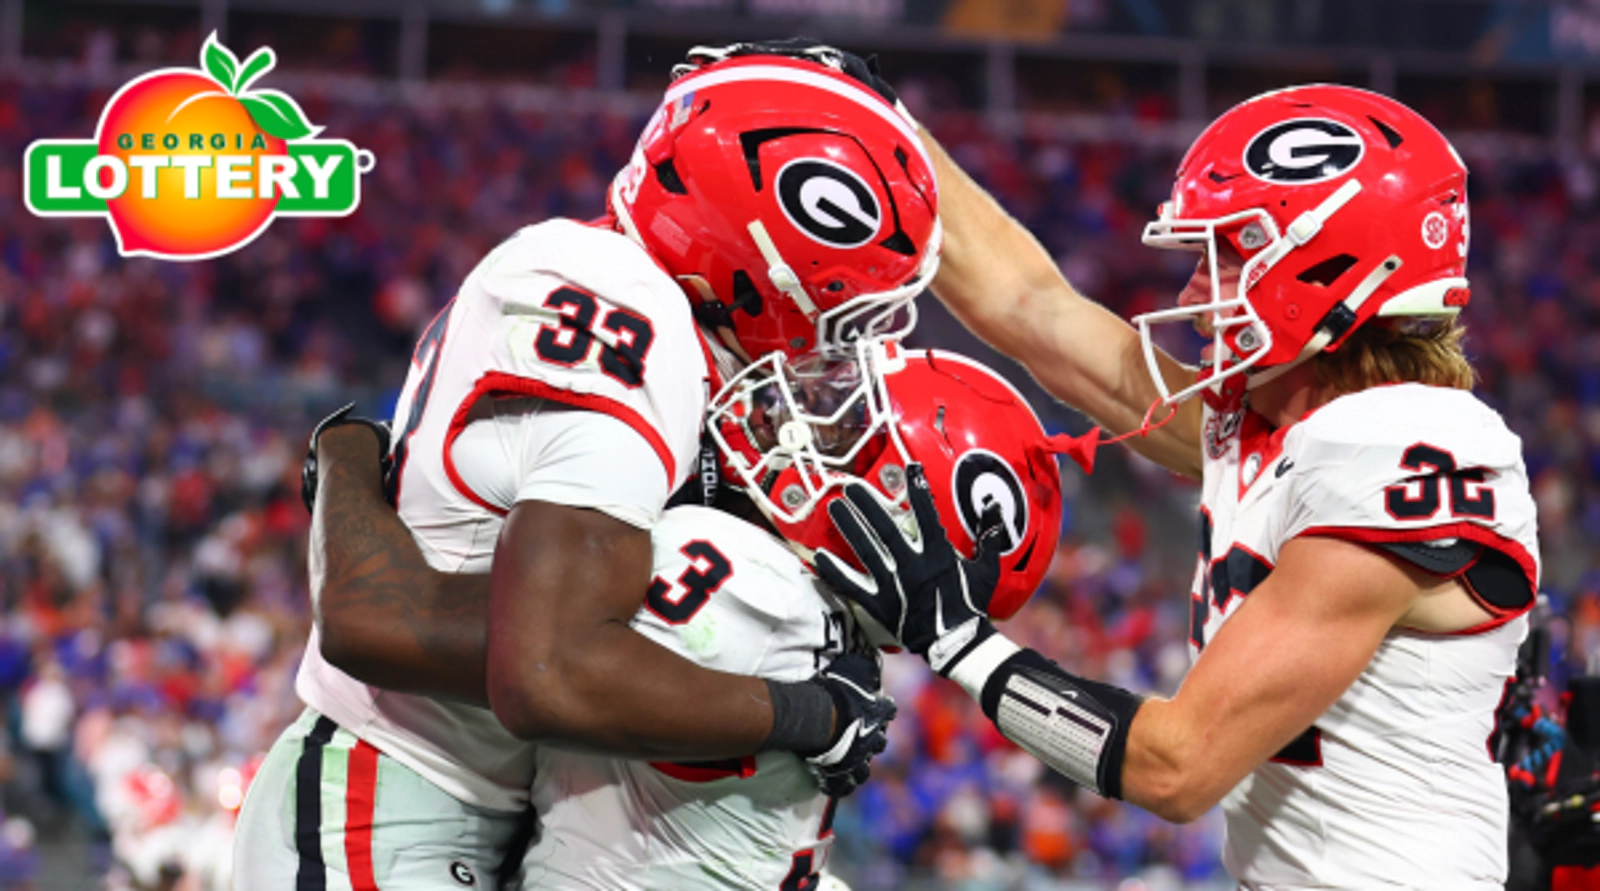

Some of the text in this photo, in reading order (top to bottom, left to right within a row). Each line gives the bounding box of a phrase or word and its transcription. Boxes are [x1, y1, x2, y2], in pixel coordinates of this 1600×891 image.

[1244, 118, 1364, 185] G
[776, 158, 881, 248] G
[533, 285, 655, 390] 33
[1384, 440, 1497, 521] 32
[645, 538, 734, 626] 3
[449, 860, 477, 887] G
